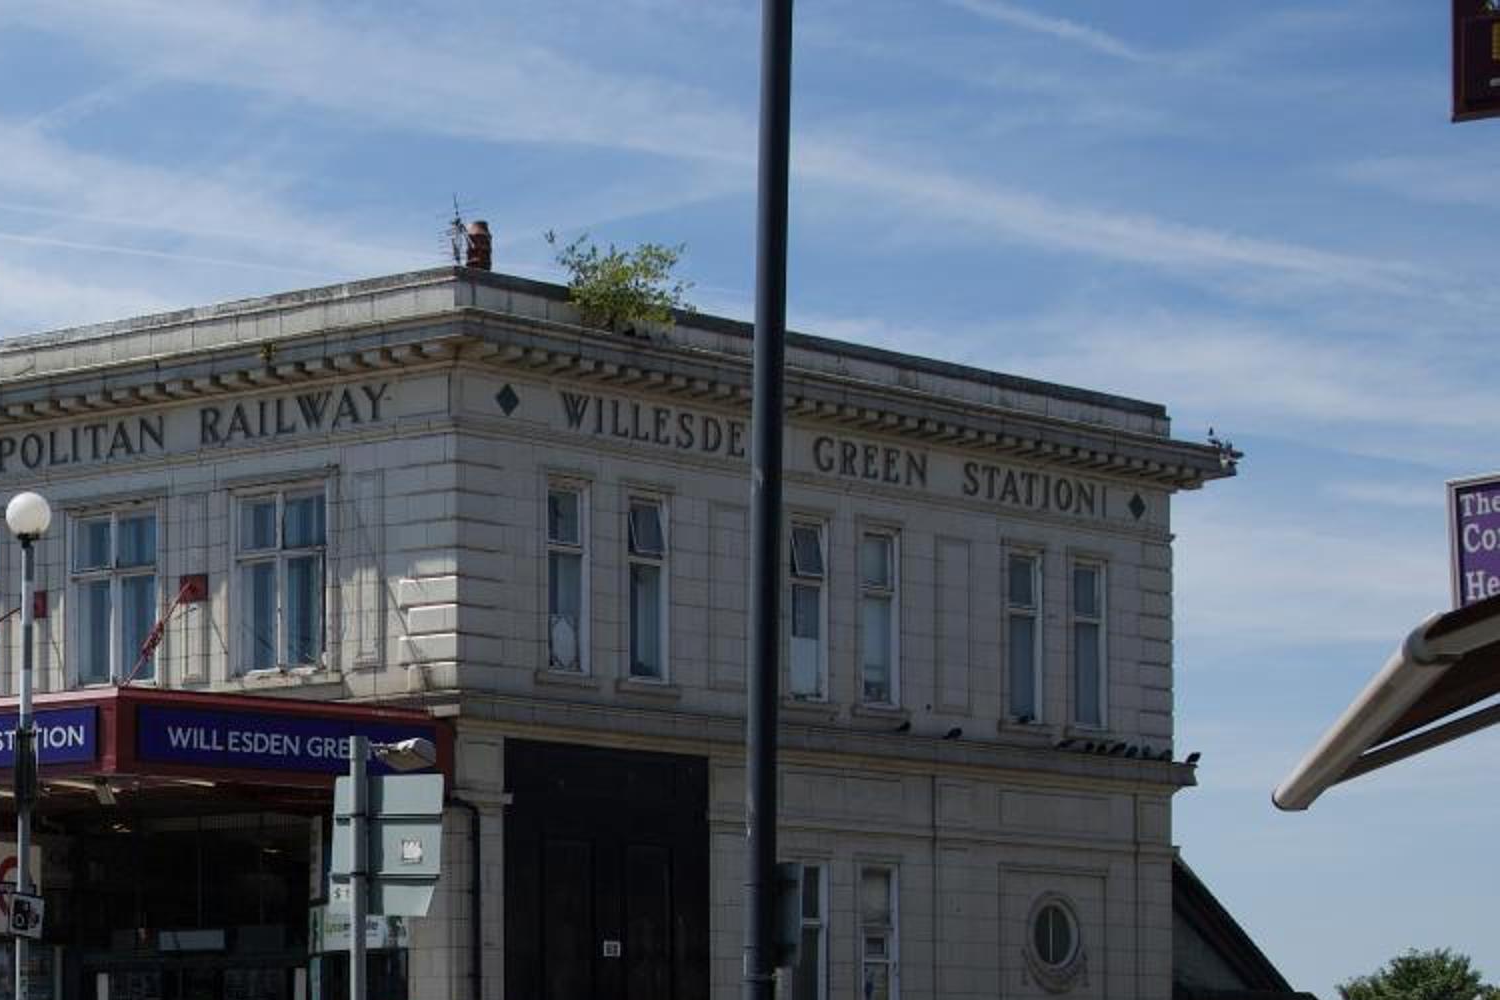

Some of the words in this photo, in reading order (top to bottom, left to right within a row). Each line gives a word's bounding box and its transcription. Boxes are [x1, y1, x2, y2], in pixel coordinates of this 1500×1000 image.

[200, 382, 389, 446] RAILWAY
[560, 390, 747, 458] WILLESDE
[813, 436, 929, 487] GREEN
[963, 461, 1096, 517] STATION
[1463, 522, 1500, 553] Co
[166, 725, 300, 756] WILLESDEN
